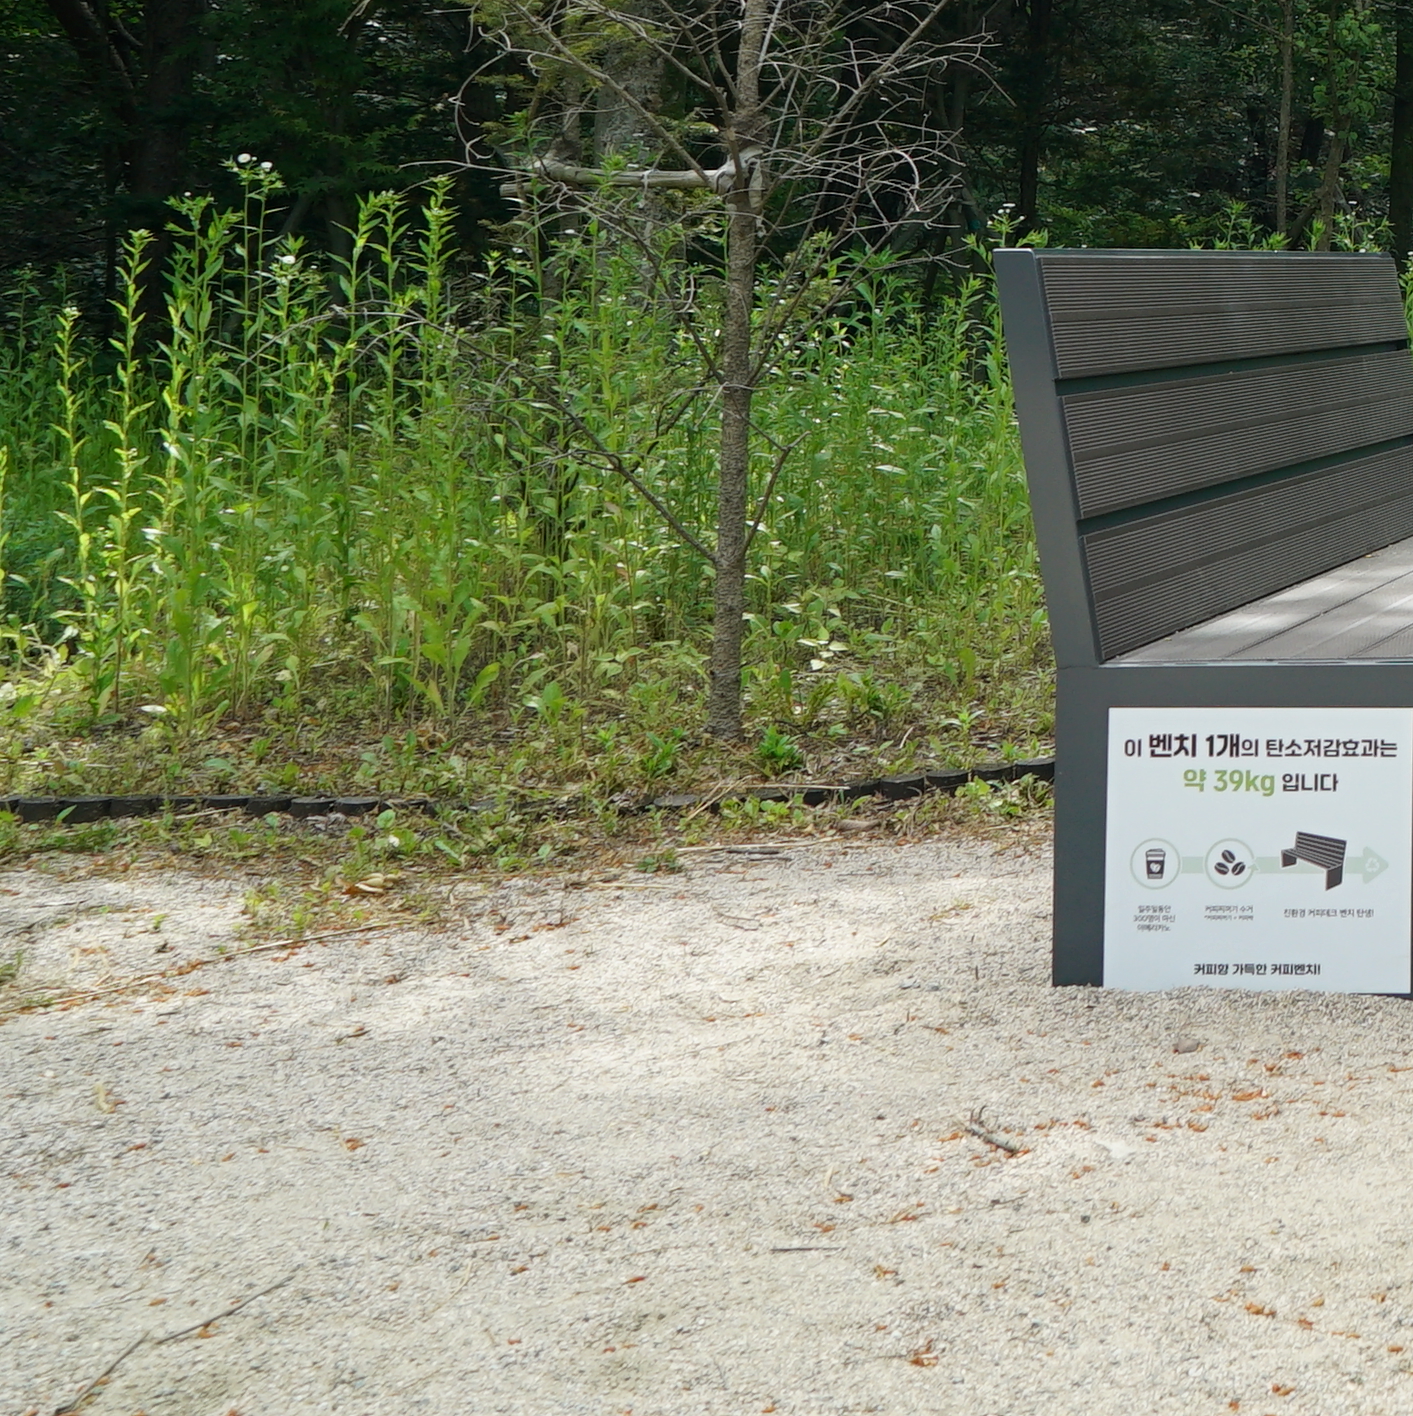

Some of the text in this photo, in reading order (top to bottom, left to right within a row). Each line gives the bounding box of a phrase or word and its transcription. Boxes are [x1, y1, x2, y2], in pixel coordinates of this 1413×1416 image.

[1124, 734, 1398, 758] 이 벤치 1개의 탄소저감효과는
[1183, 769, 1338, 796] 약 39kg 입니다
[1194, 963, 1321, 975] 커피향 가득한 커피벤치!
